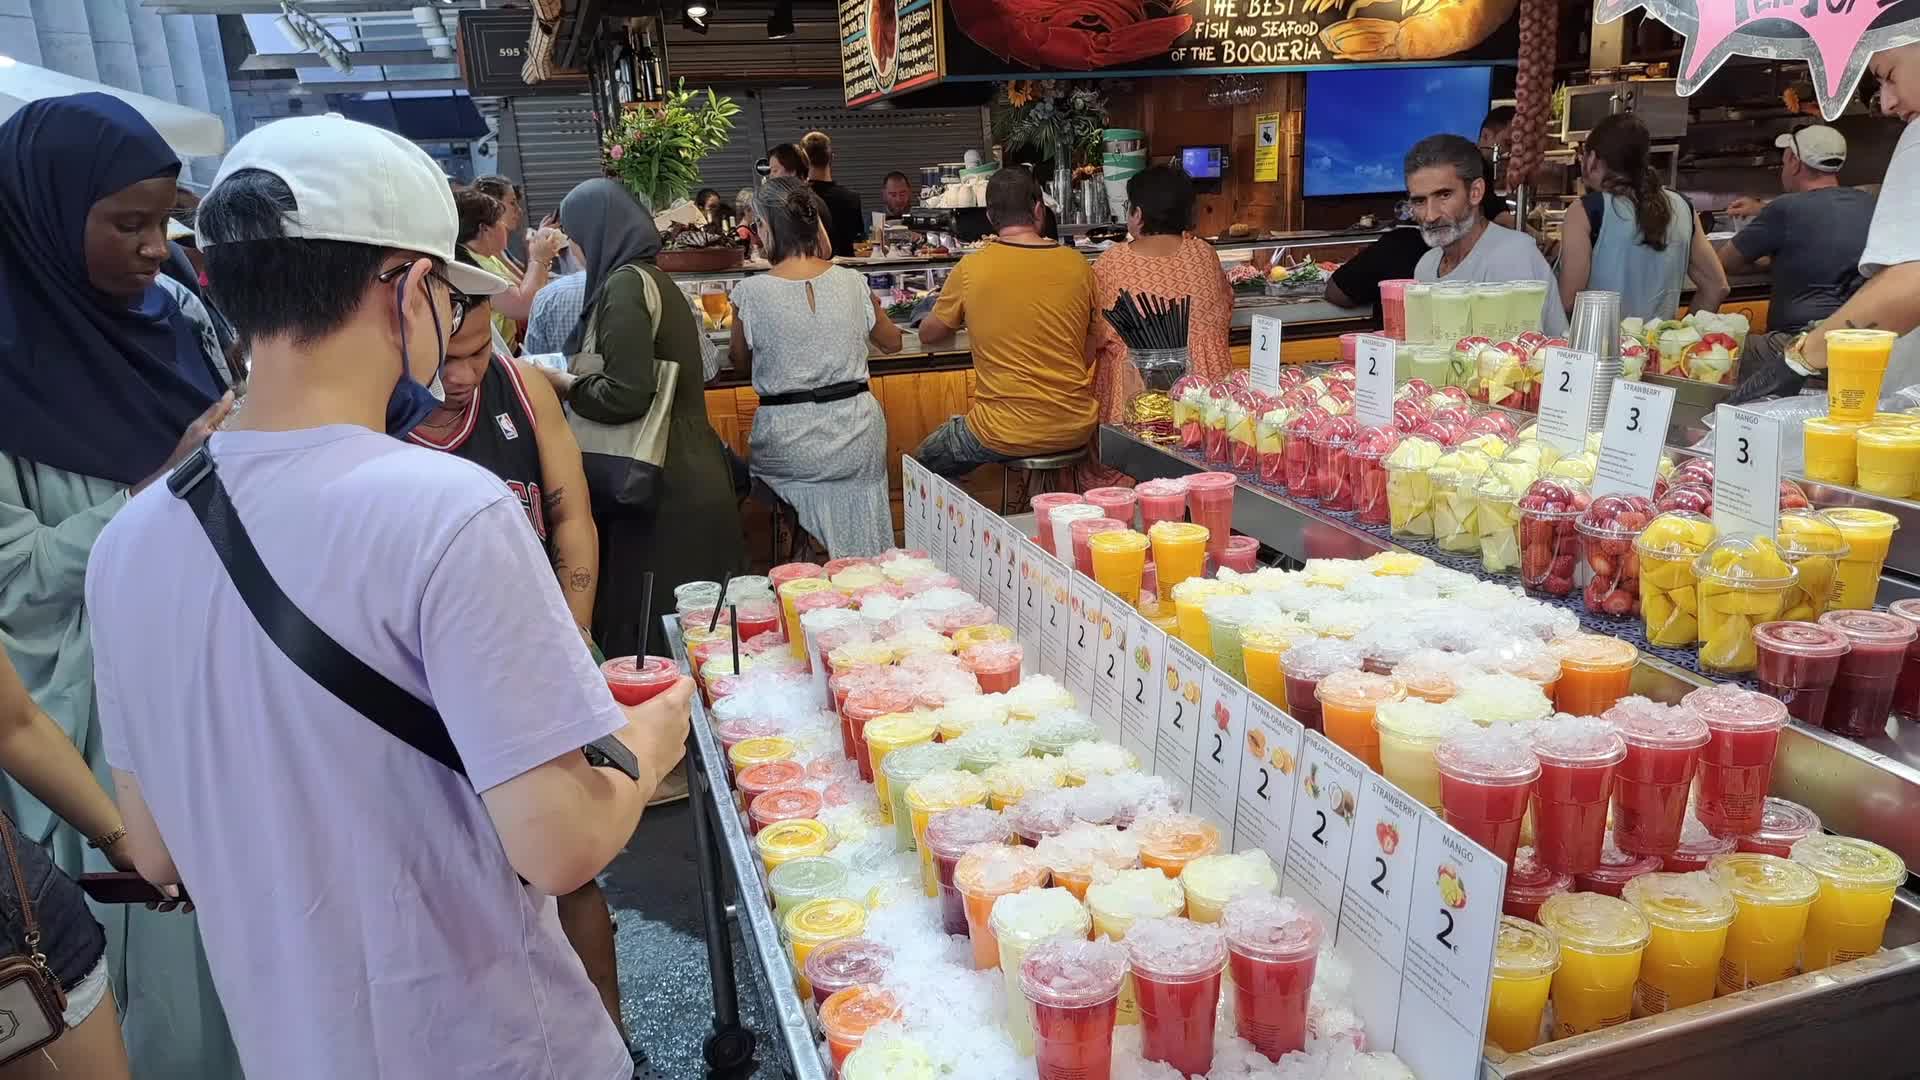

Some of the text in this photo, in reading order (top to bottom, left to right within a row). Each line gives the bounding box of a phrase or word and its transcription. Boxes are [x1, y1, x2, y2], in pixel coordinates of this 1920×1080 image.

[1205, 0, 1295, 17] THE BEST
[1235, 25, 1257, 37] AND
[1260, 21, 1319, 38] SEAFOOD
[499, 47, 521, 57] 595
[1171, 48, 1187, 62] OF
[1191, 47, 1216, 61] THE
[1623, 383, 1661, 397] STRAWBERRY
[1735, 412, 1759, 425] MANGO
[1251, 700, 1294, 736] PAPAYA-ORANGE
[1372, 782, 1417, 820] STRAWBERRY
[1442, 835, 1474, 863] MANGO
